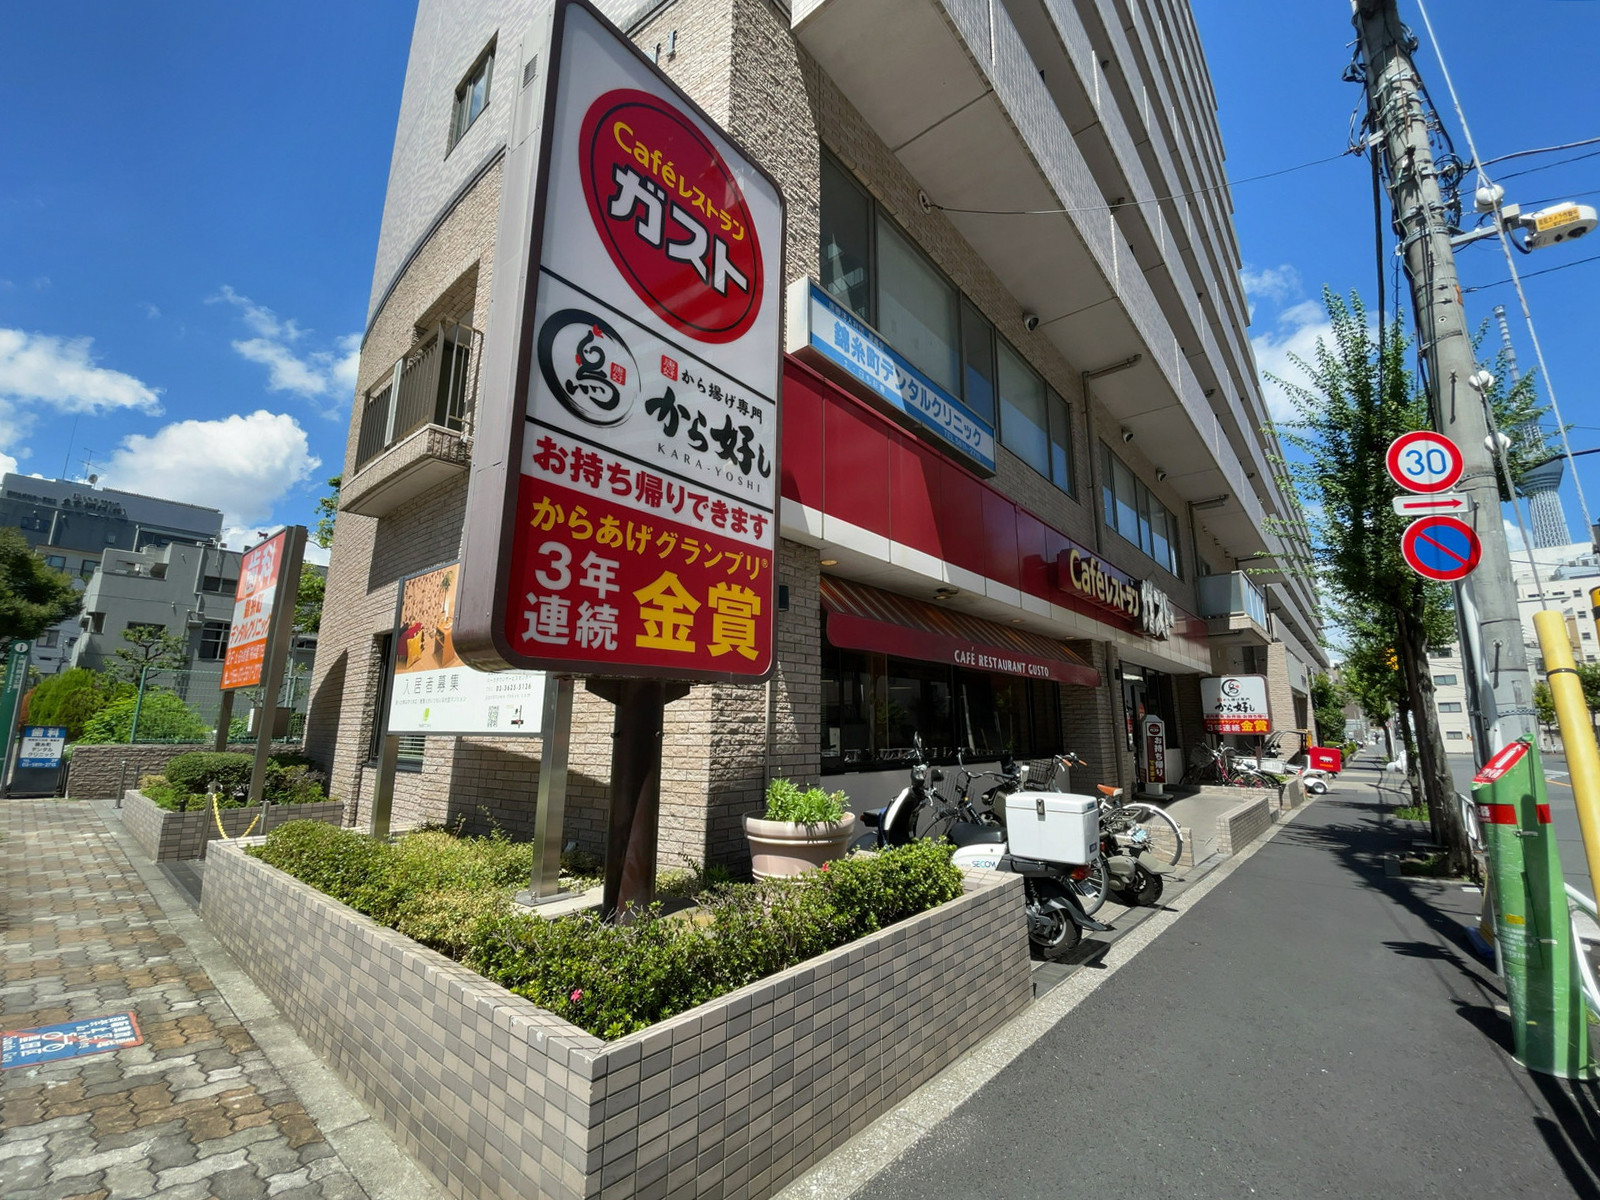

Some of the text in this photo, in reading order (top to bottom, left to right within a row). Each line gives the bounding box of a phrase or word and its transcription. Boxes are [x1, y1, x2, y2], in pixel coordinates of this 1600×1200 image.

[608, 164, 749, 295] ガスト
[682, 369, 763, 424] から揚げ専門
[834, 321, 982, 447] 錦糸町デンタルクリニック
[645, 386, 771, 478] から好し
[533, 435, 769, 541] お持ち帰りできます
[1405, 449, 1447, 476] 30
[244, 540, 277, 594] 歯科
[535, 541, 621, 600] 3年
[522, 591, 619, 651] 連続
[633, 570, 762, 661] 金賞
[403, 674, 459, 695] 入居者募集
[954, 646, 1049, 677] CAFÉ RESTAURANT GUSTO
[1214, 702, 1255, 713] から好し
[1240, 720, 1268, 732] 金賞
[1154, 737, 1163, 777] お持ち帰り
